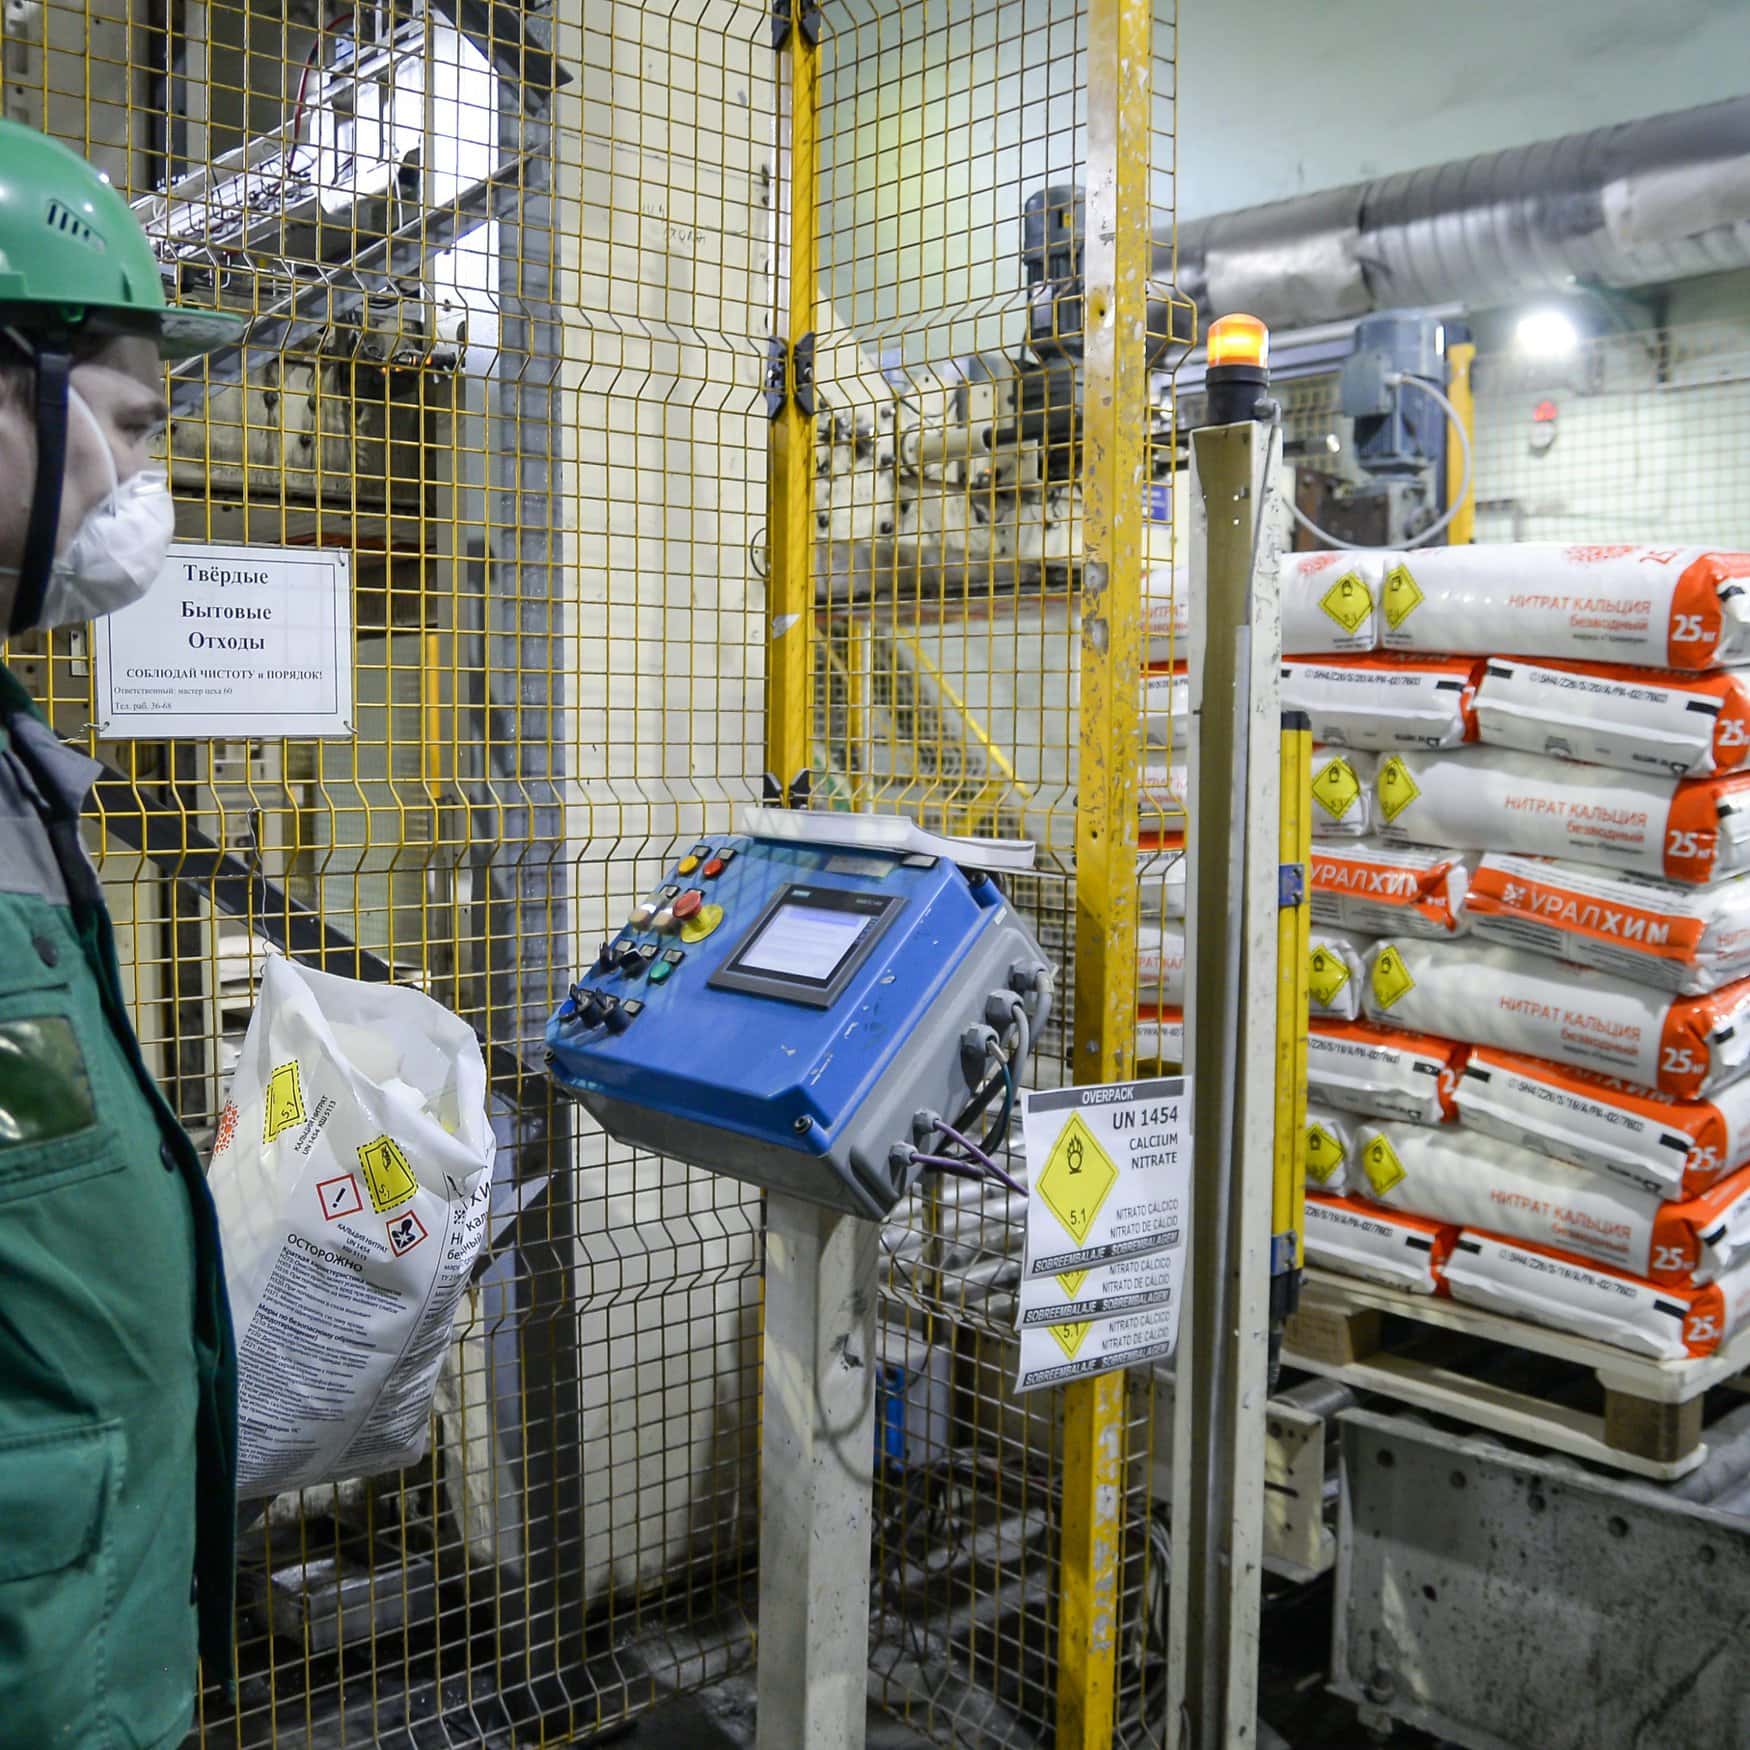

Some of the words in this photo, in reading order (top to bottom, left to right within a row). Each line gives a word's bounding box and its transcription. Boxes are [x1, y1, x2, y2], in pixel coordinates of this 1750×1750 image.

[183, 563, 269, 587] Твёрдые
[180, 600, 272, 620] Бытовые
[188, 631, 265, 650] Отходы
[126, 667, 197, 680] СОБЛЮДАЙ
[200, 668, 254, 680] ЧИСТОТУ
[266, 668, 323, 681] ПОРЯДОК!
[1505, 795, 1566, 816] НИТРАТ
[1568, 802, 1648, 827] КАЛЬЦИЯ
[1531, 886, 1670, 945] УРАЛХИМ
[1500, 996, 1560, 1022] НИТРАТ
[1563, 1009, 1641, 1041] КАЛЬЦИЯ
[1082, 1086, 1134, 1104] OVERPACK
[281, 1101, 295, 1119] 5.1
[1112, 1111, 1135, 1129] UN
[1140, 1105, 1178, 1127] 1454
[1129, 1132, 1178, 1151] CALCIUM
[1131, 1152, 1178, 1170] NITRATE
[1116, 1205, 1147, 1220] NITRATO
[1490, 1189, 1549, 1217] НИТРАТ
[1070, 1209, 1087, 1225] 5.1
[1110, 1223, 1140, 1239] NITRATO
[1142, 1220, 1151, 1231] DE
[287, 1233, 363, 1272] ОСТОРОЖНО
[1034, 1248, 1106, 1272] SOBREEMBALAJE
[1109, 1260, 1141, 1275] NITRATO
[1102, 1278, 1133, 1294] NITRATO
[1026, 1301, 1097, 1322] SOBREEMBALAJE
[1109, 1318, 1139, 1333] NITRATO
[1102, 1334, 1131, 1350] NITRATO
[1025, 1360, 1097, 1385] SOBREEMBALAJE
